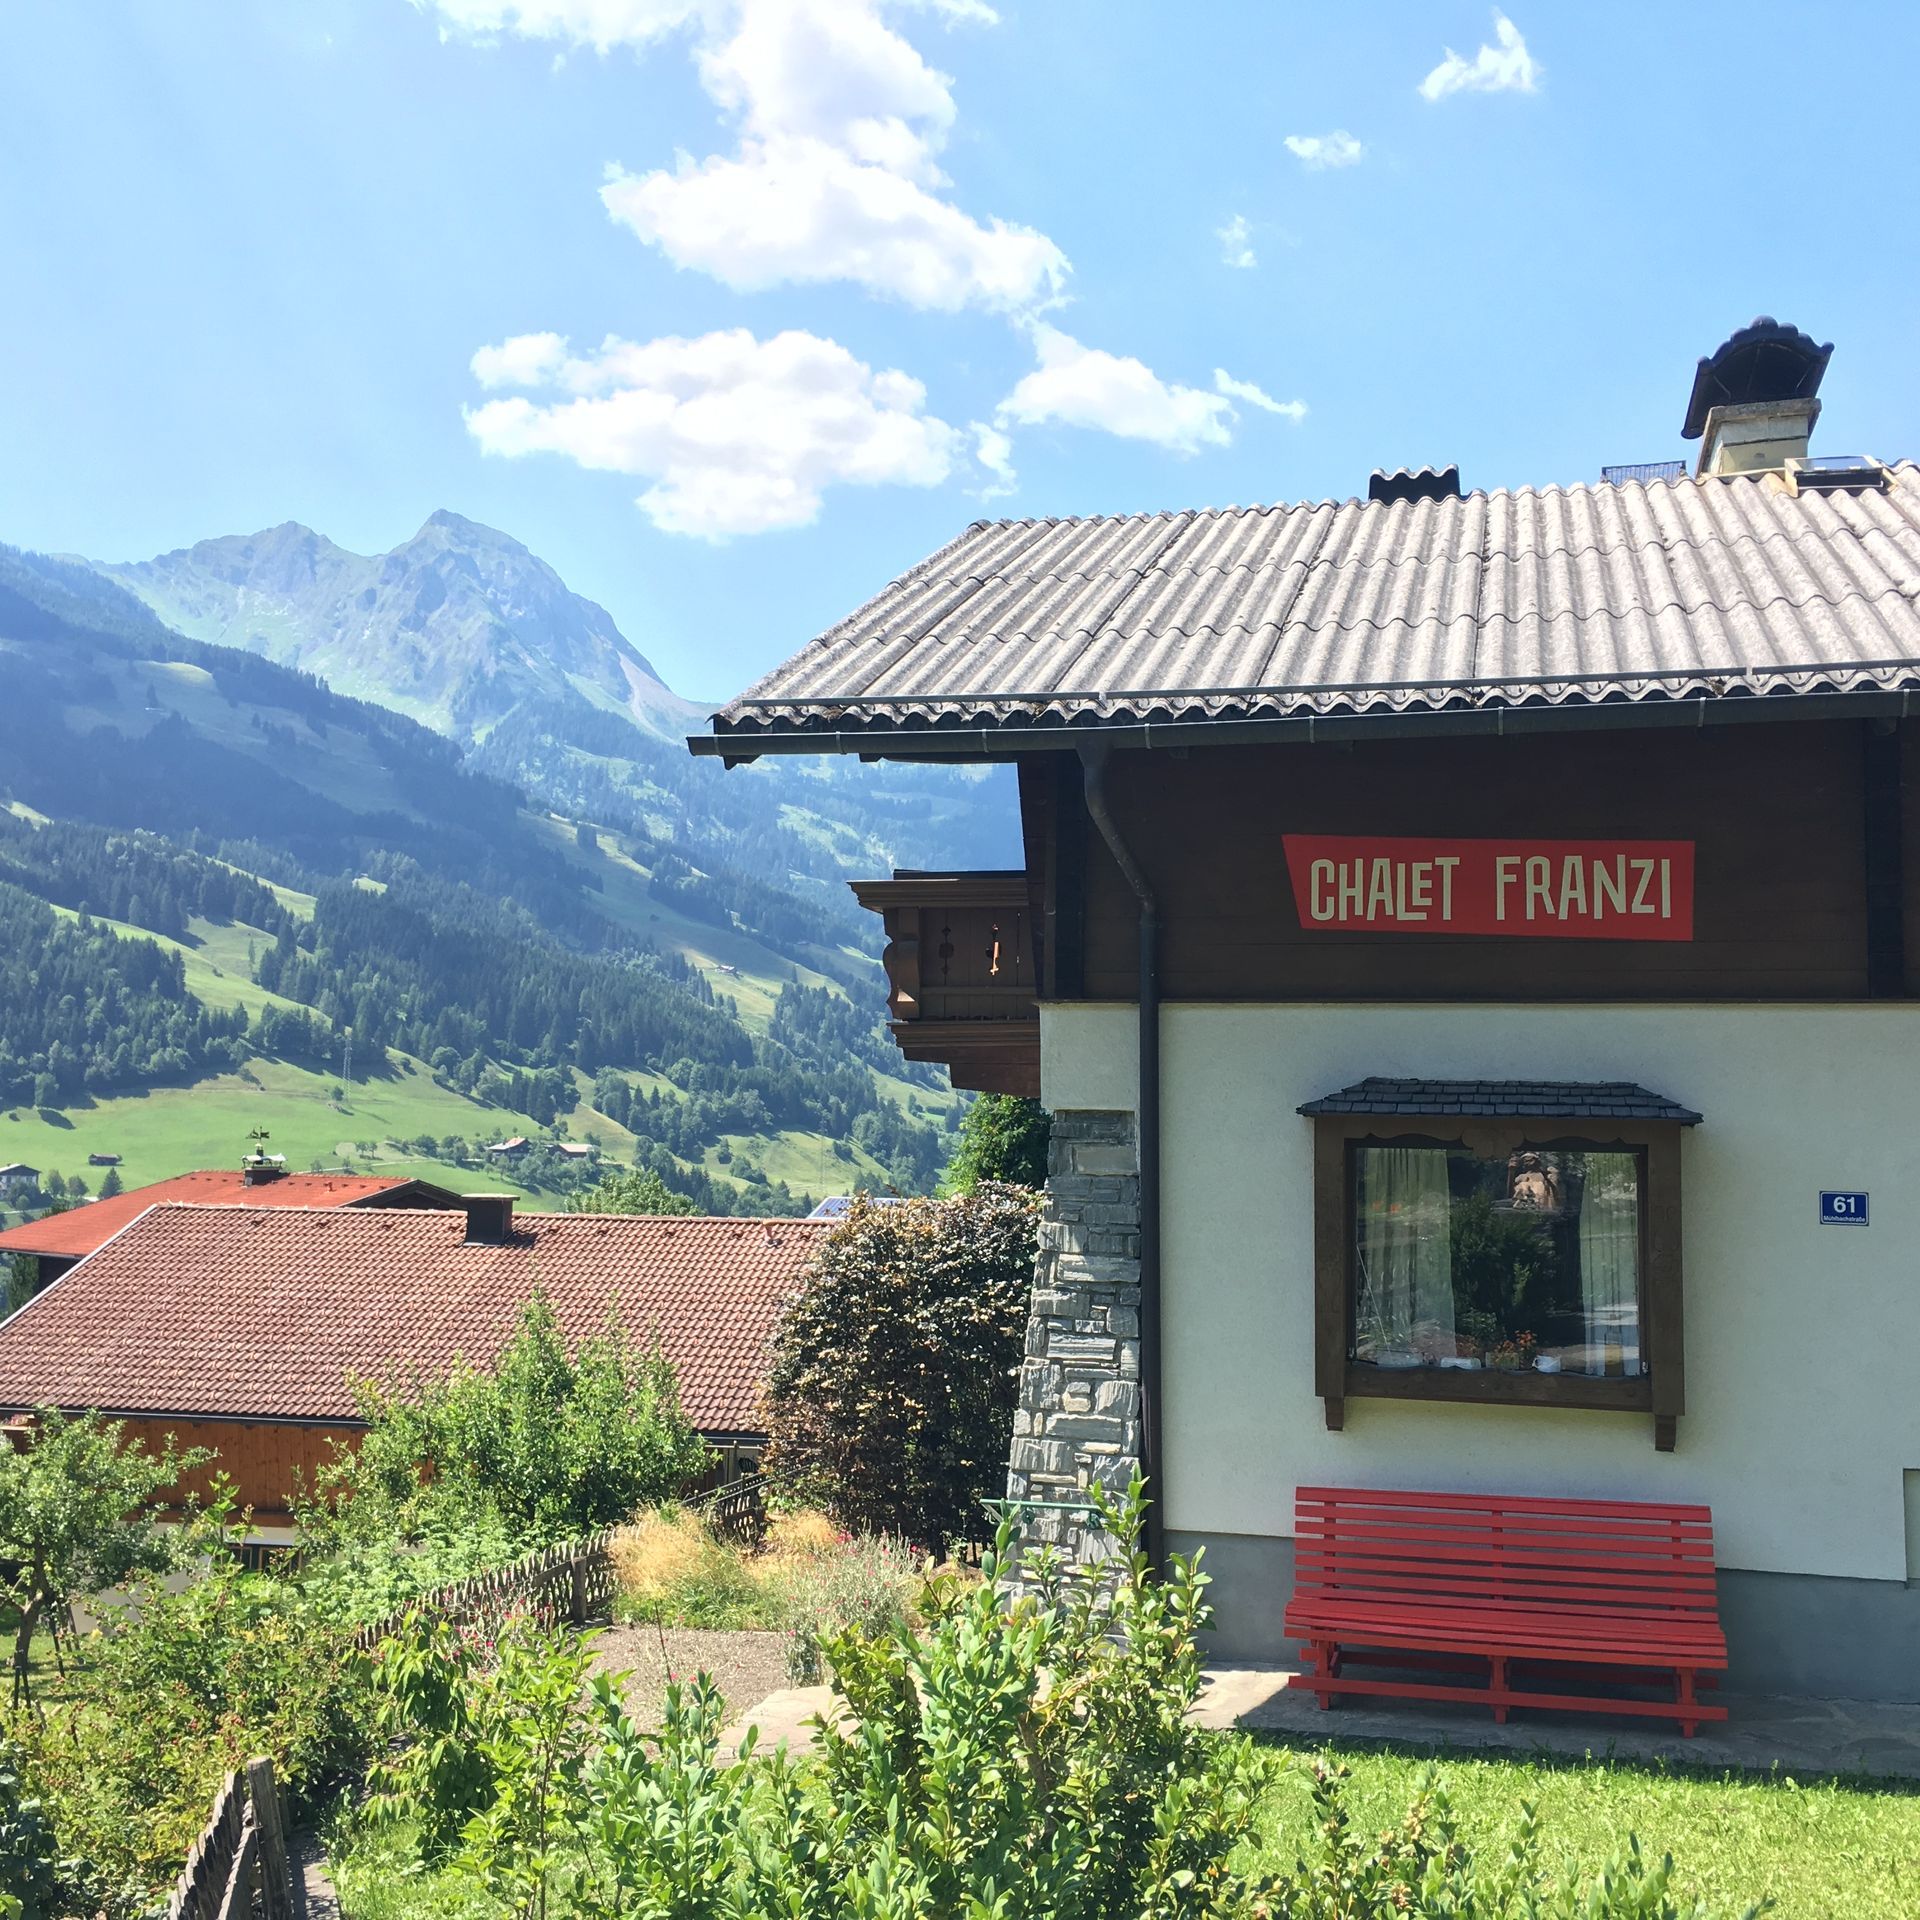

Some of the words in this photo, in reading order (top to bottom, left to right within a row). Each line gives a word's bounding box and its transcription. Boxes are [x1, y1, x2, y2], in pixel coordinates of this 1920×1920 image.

[1310, 856, 1460, 921] CHALET
[1496, 854, 1671, 920] FRANZI
[1834, 1196, 1855, 1213] 61
